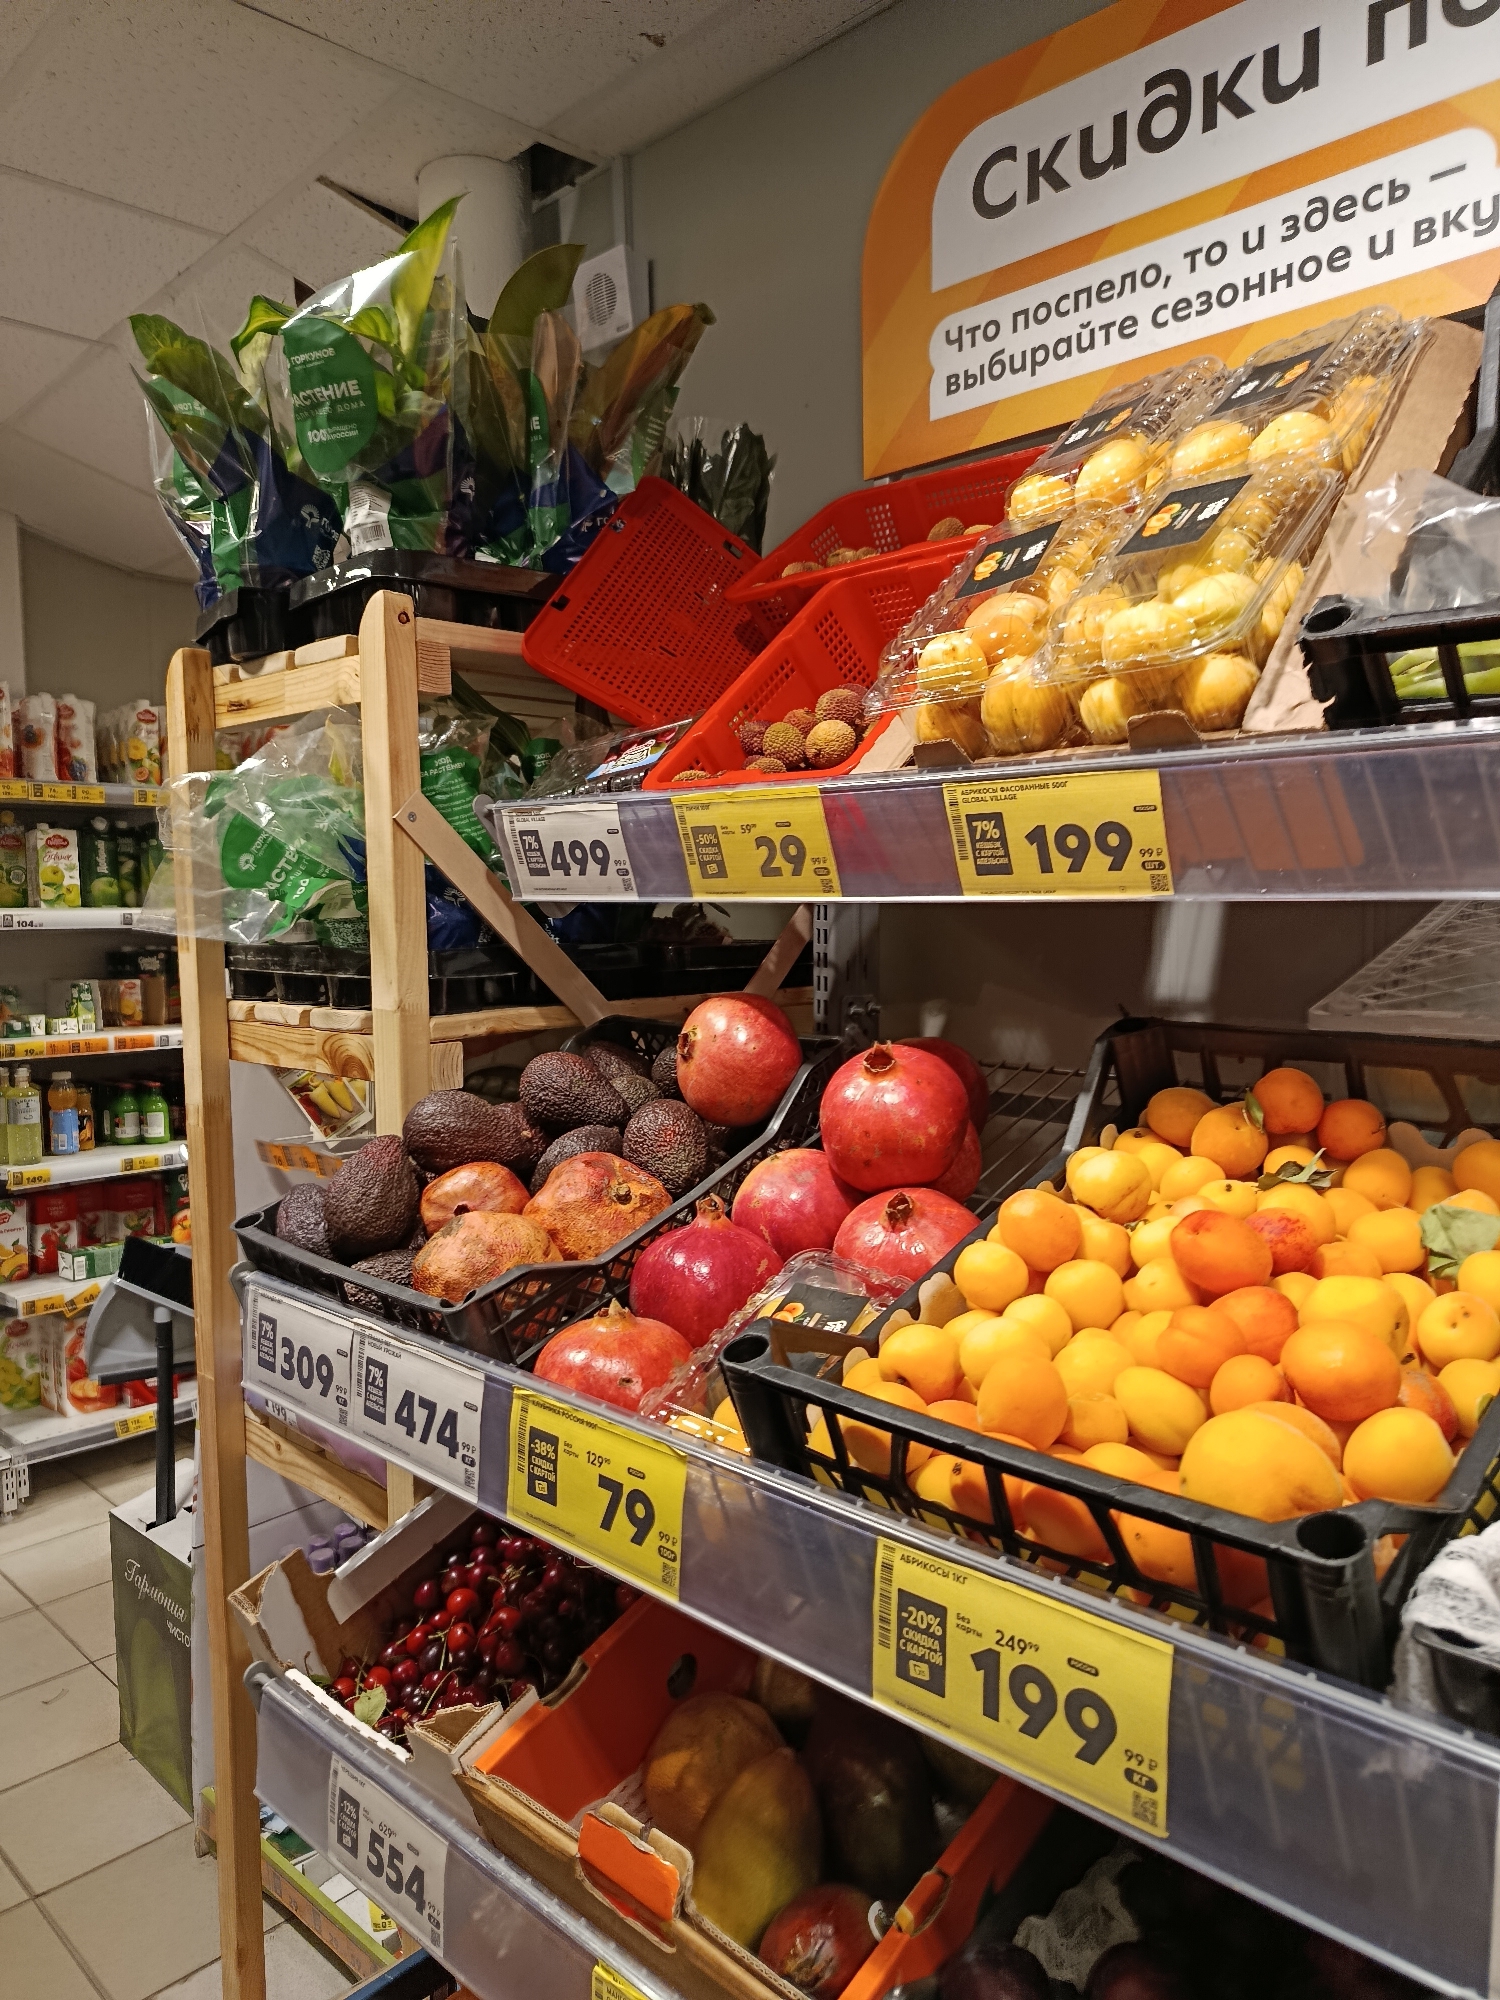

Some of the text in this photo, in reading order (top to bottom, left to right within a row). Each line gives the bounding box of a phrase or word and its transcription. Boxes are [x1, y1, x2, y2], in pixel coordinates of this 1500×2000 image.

[971, 26, 1321, 220] Скидки
[945, 320, 1000, 353] Что
[1010, 262, 1173, 332] поспело,
[1183, 239, 1229, 275] то
[1241, 225, 1265, 255] и
[1280, 178, 1411, 243] здесь
[945, 313, 1139, 397] выбирайте
[1150, 244, 1352, 330] сезонное
[1368, 228, 1395, 261] и
[292, 379, 362, 408] АСТЕНИЕ
[961, 787, 998, 796] АБРИКОСЫ
[1000, 781, 1050, 793] ФАСОВАННЫЕ
[962, 793, 1018, 804] GLOBAL VILLAGE
[695, 833, 718, 845] -50%
[971, 820, 1000, 840] 7%
[522, 835, 539, 850] 7%
[1024, 820, 1133, 874] 199
[1139, 847, 1154, 858] 99
[551, 839, 611, 877] 499
[755, 835, 807, 878] 29
[16, 920, 34, 928] 104
[26, 1175, 43, 1185] 149
[261, 1320, 274, 1340] 7%
[280, 1336, 334, 1398] 309
[368, 1364, 384, 1388] 7%
[394, 1389, 460, 1460] 474
[461, 1441, 471, 1454] 99
[530, 1438, 556, 1460] -38%
[531, 1456, 554, 1472] СКИДКА
[534, 1465, 556, 1483] КАРТОЙ
[598, 1473, 655, 1547] 79
[658, 1530, 671, 1544] 99
[899, 1553, 968, 1586] АБРИКОСЫ 1КГ
[124, 1558, 188, 1624] Гармония
[901, 1606, 943, 1637] -20%
[955, 1612, 971, 1625] Без
[902, 1627, 940, 1651] СКИДКА
[955, 1622, 983, 1639] карты
[907, 1639, 943, 1667] КАРТОЙ
[970, 1647, 1118, 1765] 199
[1124, 1748, 1145, 1768] 99
[340, 1800, 357, 1820] -12%
[366, 1828, 426, 1917] 554
